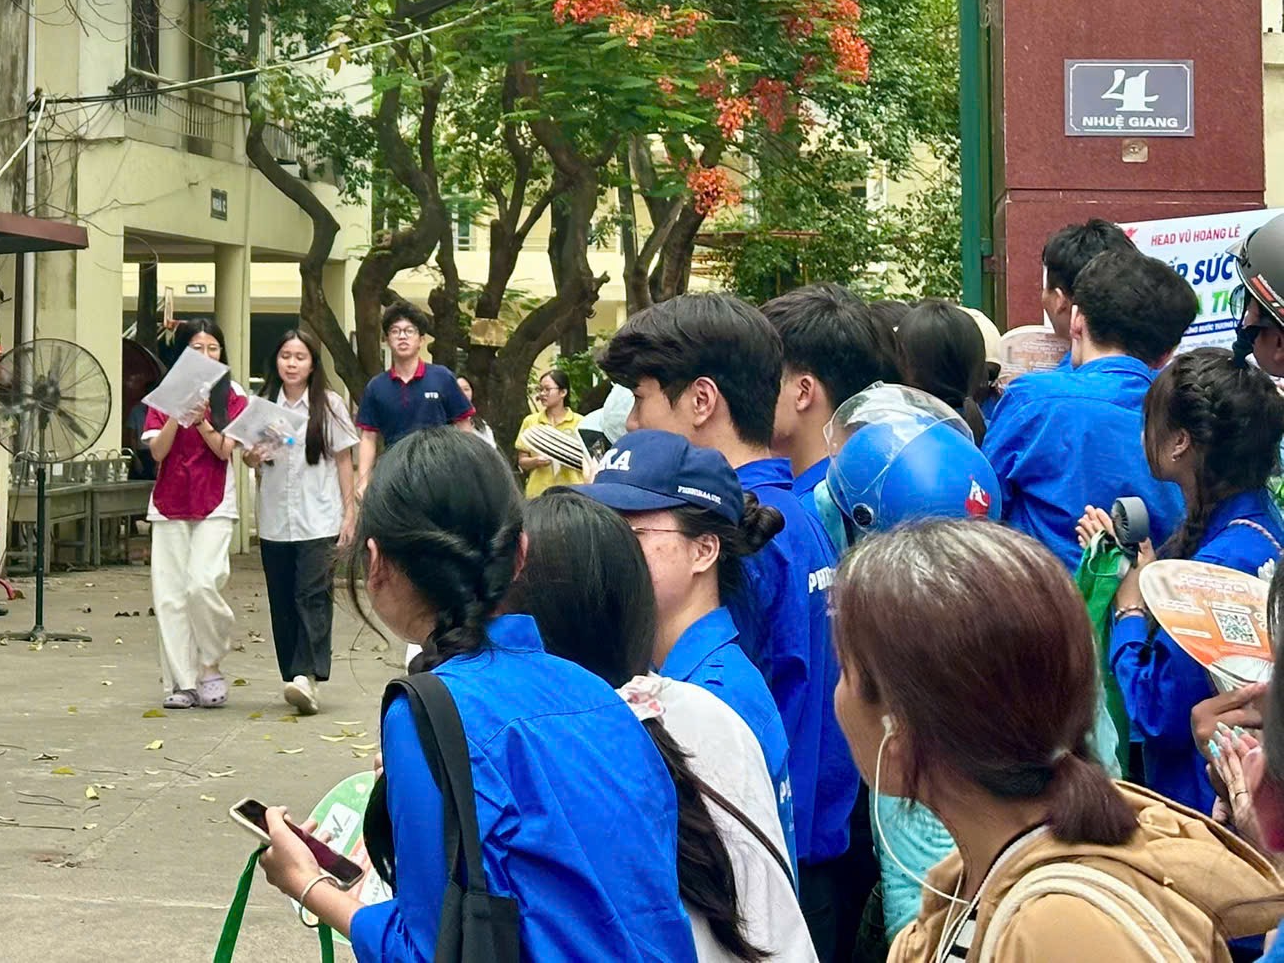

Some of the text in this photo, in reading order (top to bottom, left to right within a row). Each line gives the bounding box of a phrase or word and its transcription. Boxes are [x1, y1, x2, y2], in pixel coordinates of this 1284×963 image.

[1100, 68, 1159, 112] 4
[1082, 114, 1179, 130] NHUỆ GIANG
[1151, 232, 1176, 246] HEAD
[1192, 252, 1237, 285] SỨC
